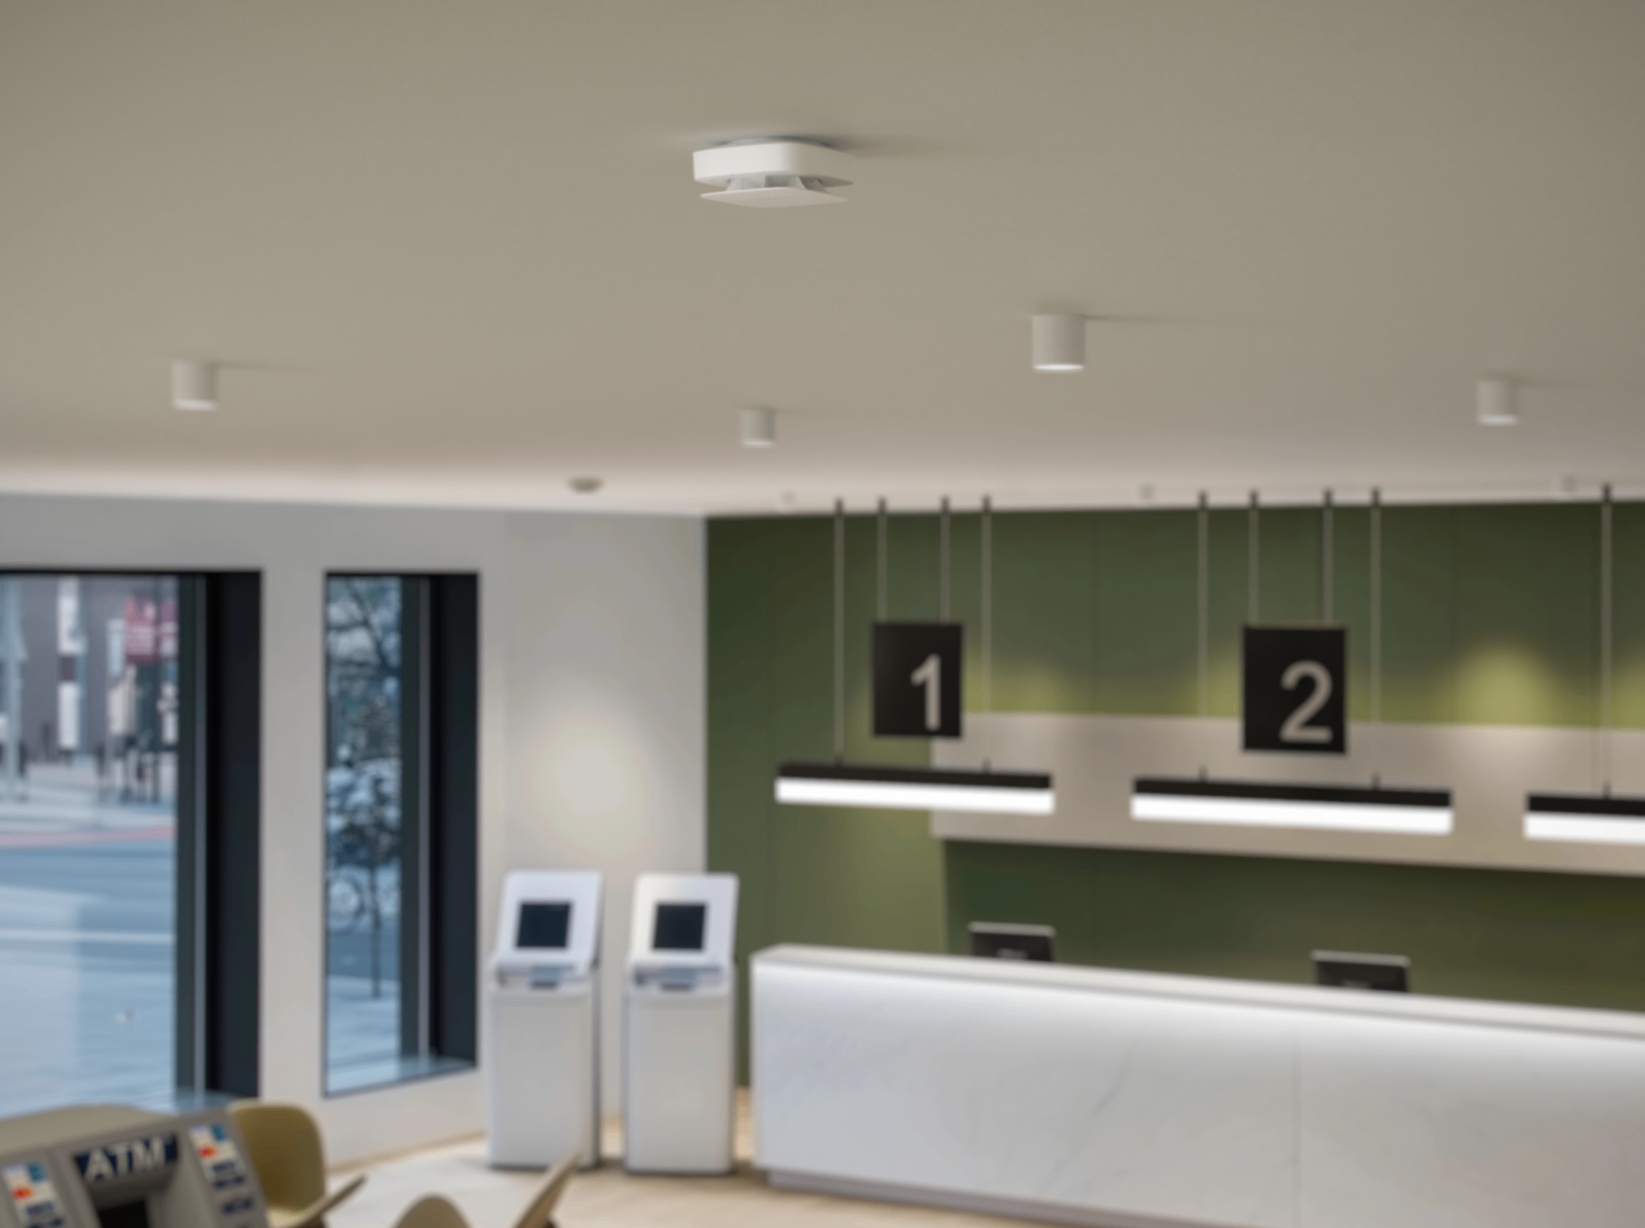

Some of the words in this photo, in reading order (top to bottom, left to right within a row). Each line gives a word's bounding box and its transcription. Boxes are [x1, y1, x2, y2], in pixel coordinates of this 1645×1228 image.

[909, 652, 943, 732] 1
[1278, 659, 1335, 744] 2
[85, 1136, 167, 1181] ATM
